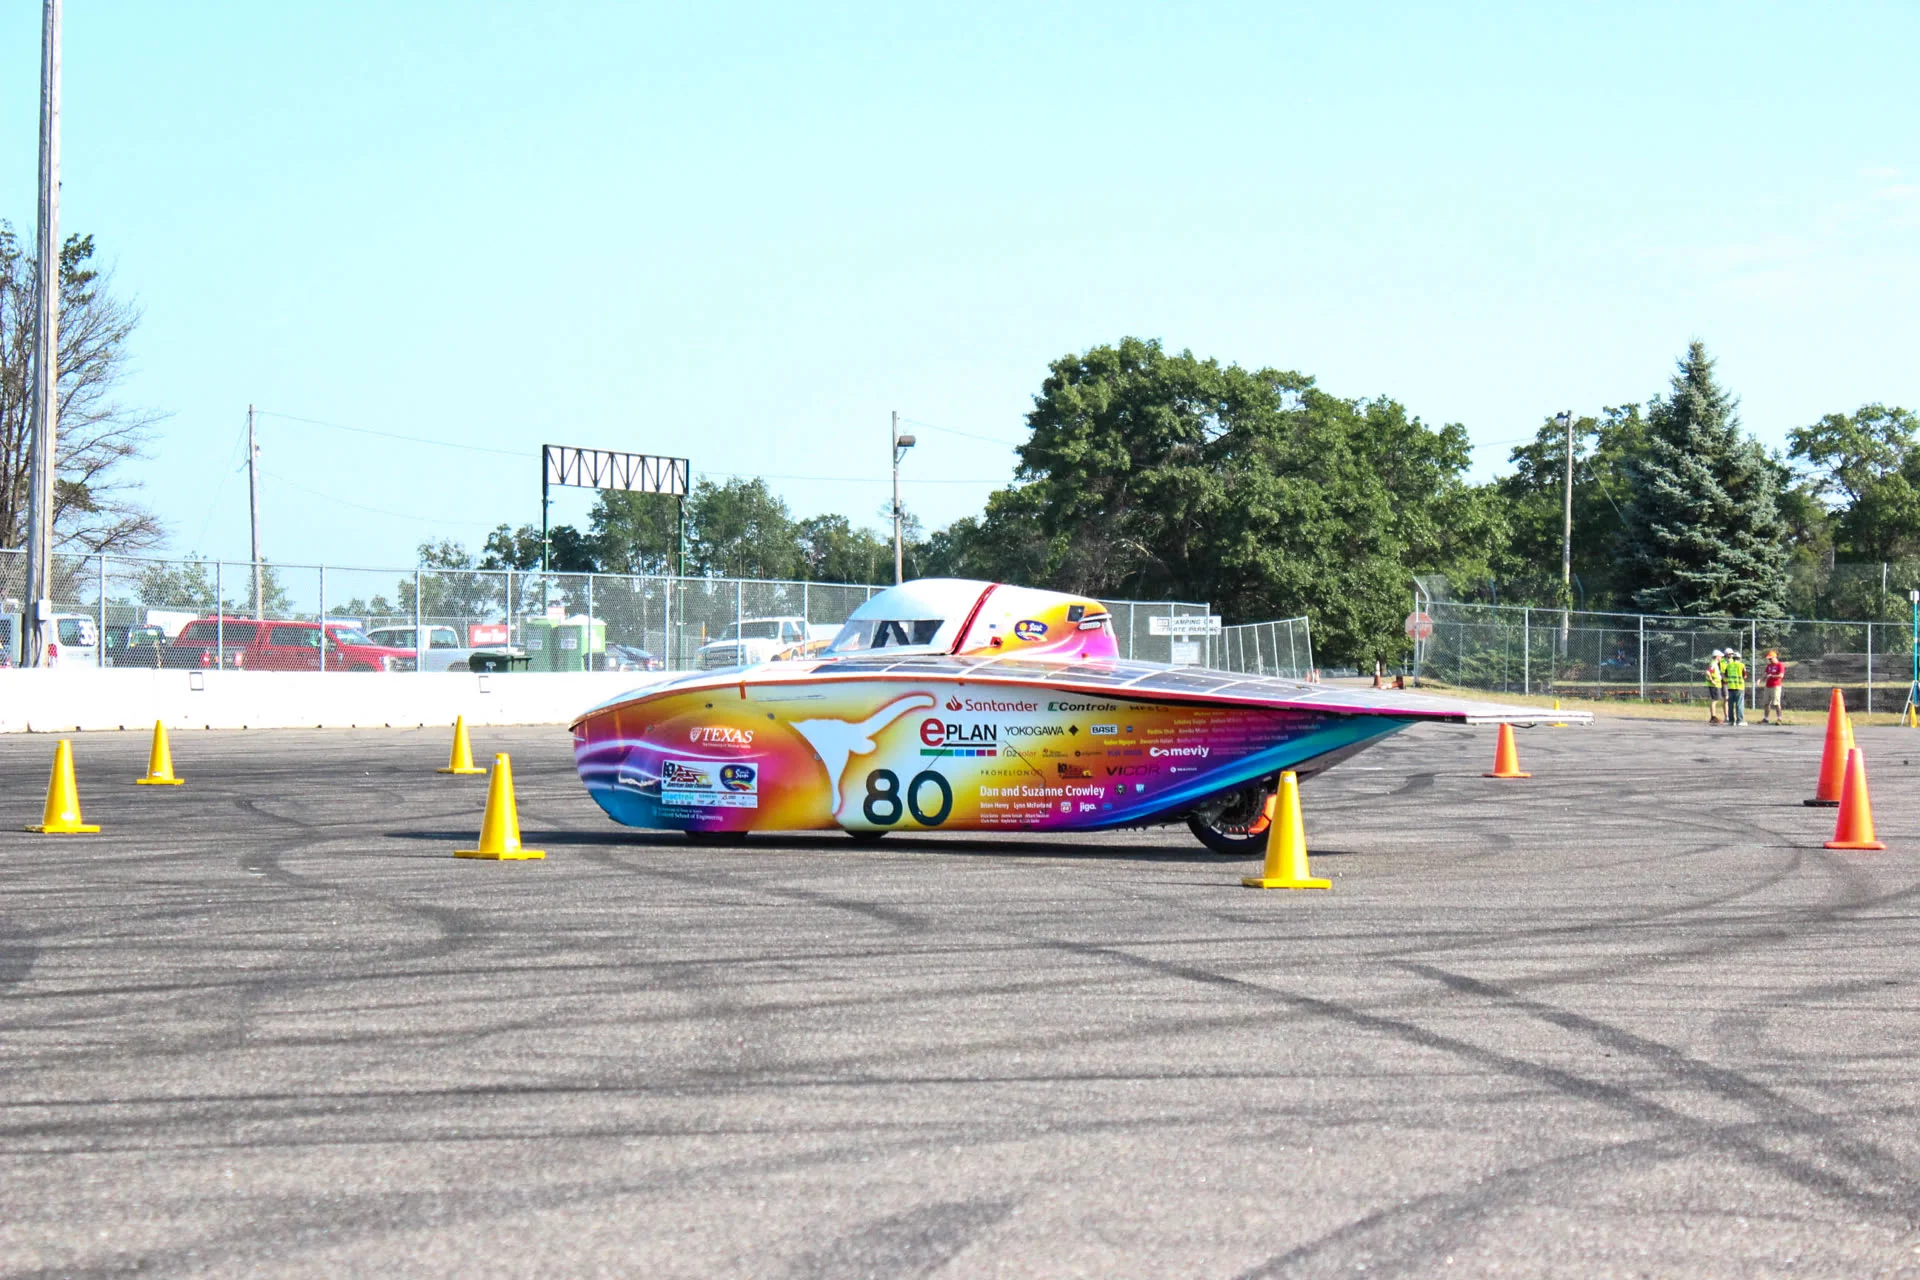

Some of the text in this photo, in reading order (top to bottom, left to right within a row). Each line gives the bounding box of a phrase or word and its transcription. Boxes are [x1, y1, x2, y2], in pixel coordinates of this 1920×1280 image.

[965, 698, 1038, 712] Santander
[703, 727, 754, 743] TEXAS
[1004, 726, 1065, 736] YOKOGAWA
[1091, 726, 1118, 734] BASE
[1170, 745, 1209, 758] meviy
[1105, 765, 1160, 777] VICOR
[863, 768, 953, 826] 80
[980, 785, 1105, 799] Dan and Suzanne Crowley
